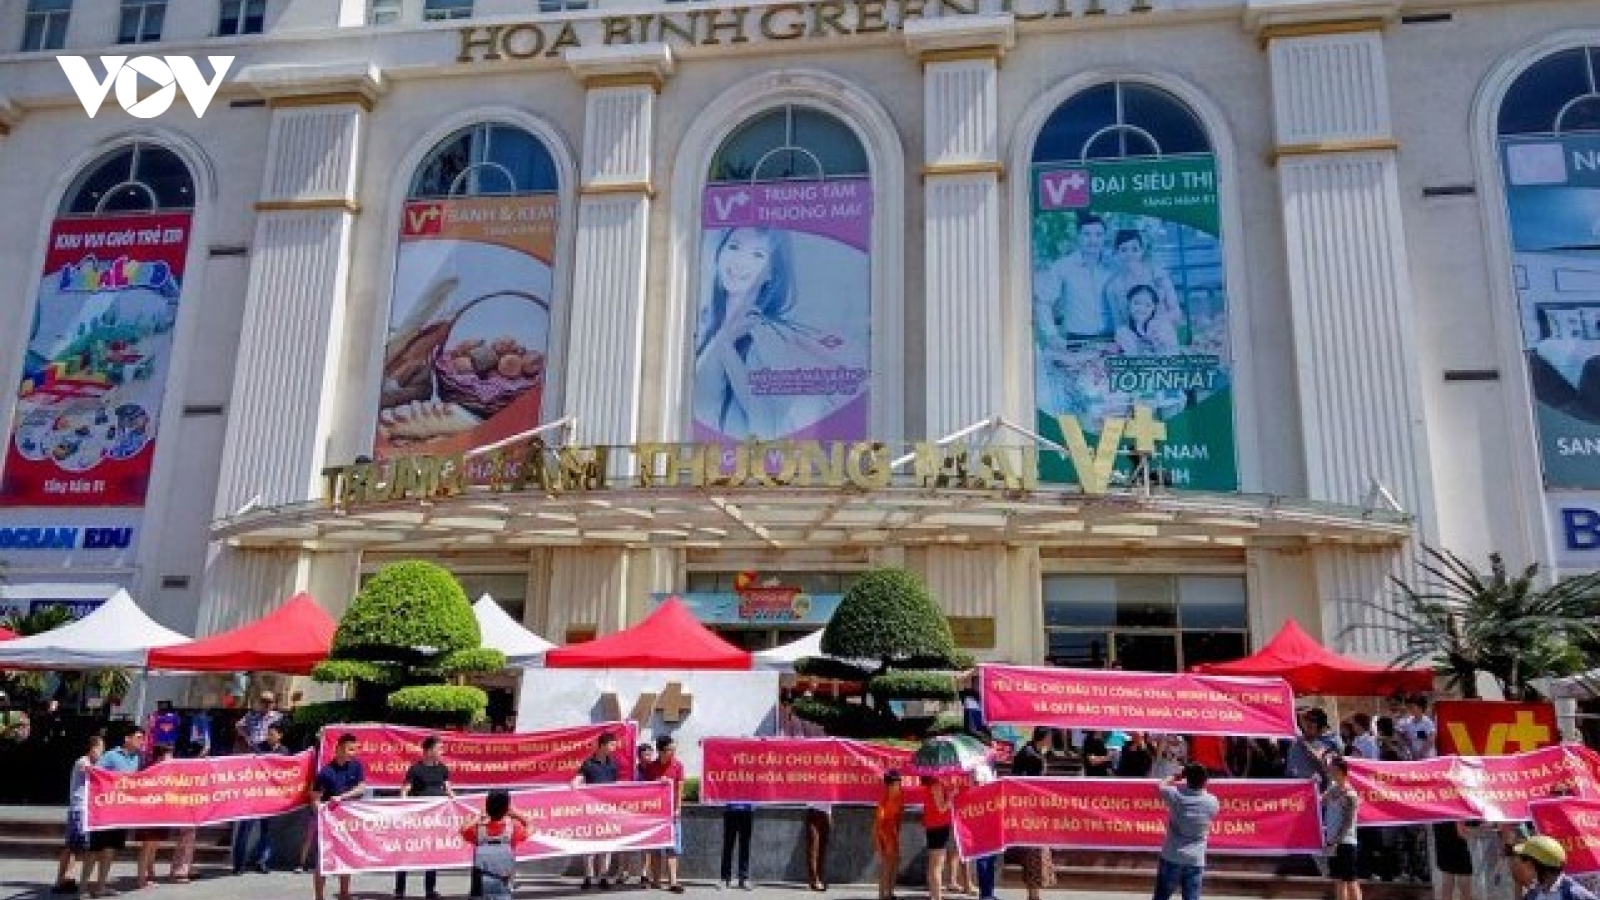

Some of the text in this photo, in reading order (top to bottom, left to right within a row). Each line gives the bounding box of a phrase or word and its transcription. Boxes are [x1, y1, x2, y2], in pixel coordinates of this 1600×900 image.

[1091, 175, 1125, 196] ĐẠI
[1131, 170, 1176, 191] SIÊU
[82, 527, 134, 549] EDU
